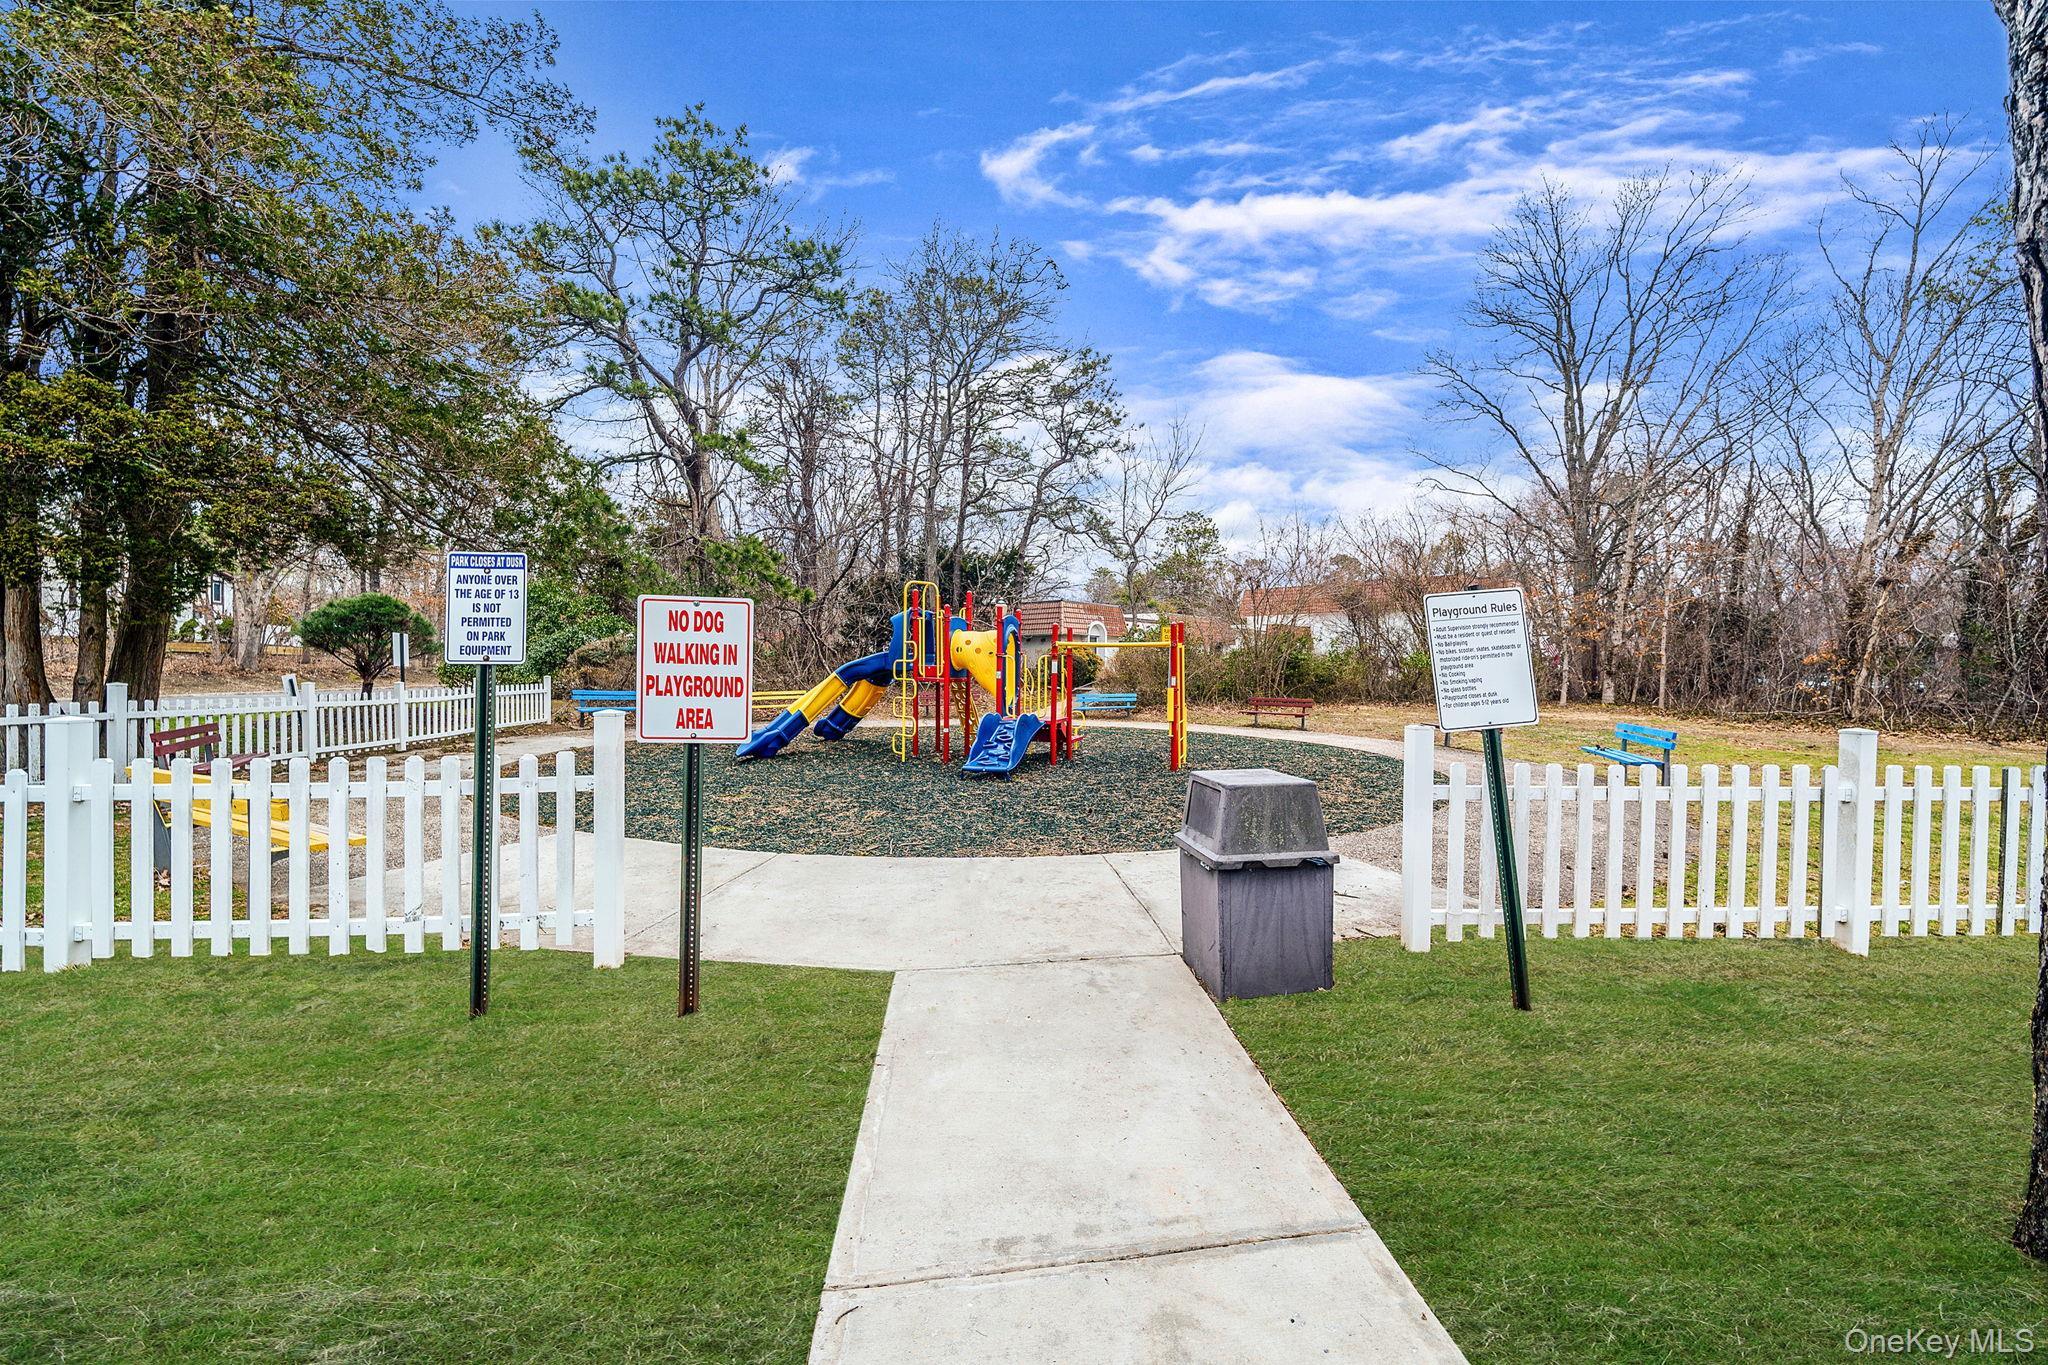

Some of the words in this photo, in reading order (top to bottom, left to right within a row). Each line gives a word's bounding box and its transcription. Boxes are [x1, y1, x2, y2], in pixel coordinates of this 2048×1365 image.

[451, 556, 469, 566] PARK
[470, 556, 495, 567] CLOSES
[496, 557, 505, 567] AT
[506, 557, 524, 568] DUSK
[456, 575, 492, 585] ANYONE
[495, 575, 518, 585] OVER
[455, 589, 472, 599] THE
[475, 589, 492, 599] AGE
[494, 589, 506, 599] OF
[509, 589, 519, 599] 13
[472, 603, 481, 613] IS
[483, 603, 501, 613] NOT
[1432, 604, 1487, 619] Playground
[1491, 603, 1517, 612] Rules
[461, 617, 512, 627] PERMITTED
[668, 610, 690, 632] NO
[694, 611, 724, 633] DOG
[1447, 624, 1471, 632] Supervision
[467, 631, 479, 641] ON
[482, 631, 506, 641] PARK
[1481, 630, 1493, 638] guest
[460, 645, 512, 656] EQUIPMENT
[654, 643, 719, 665] WALKING
[723, 644, 737, 665] IN
[646, 675, 744, 698] PLAYGROUND
[676, 708, 713, 729] AREA
